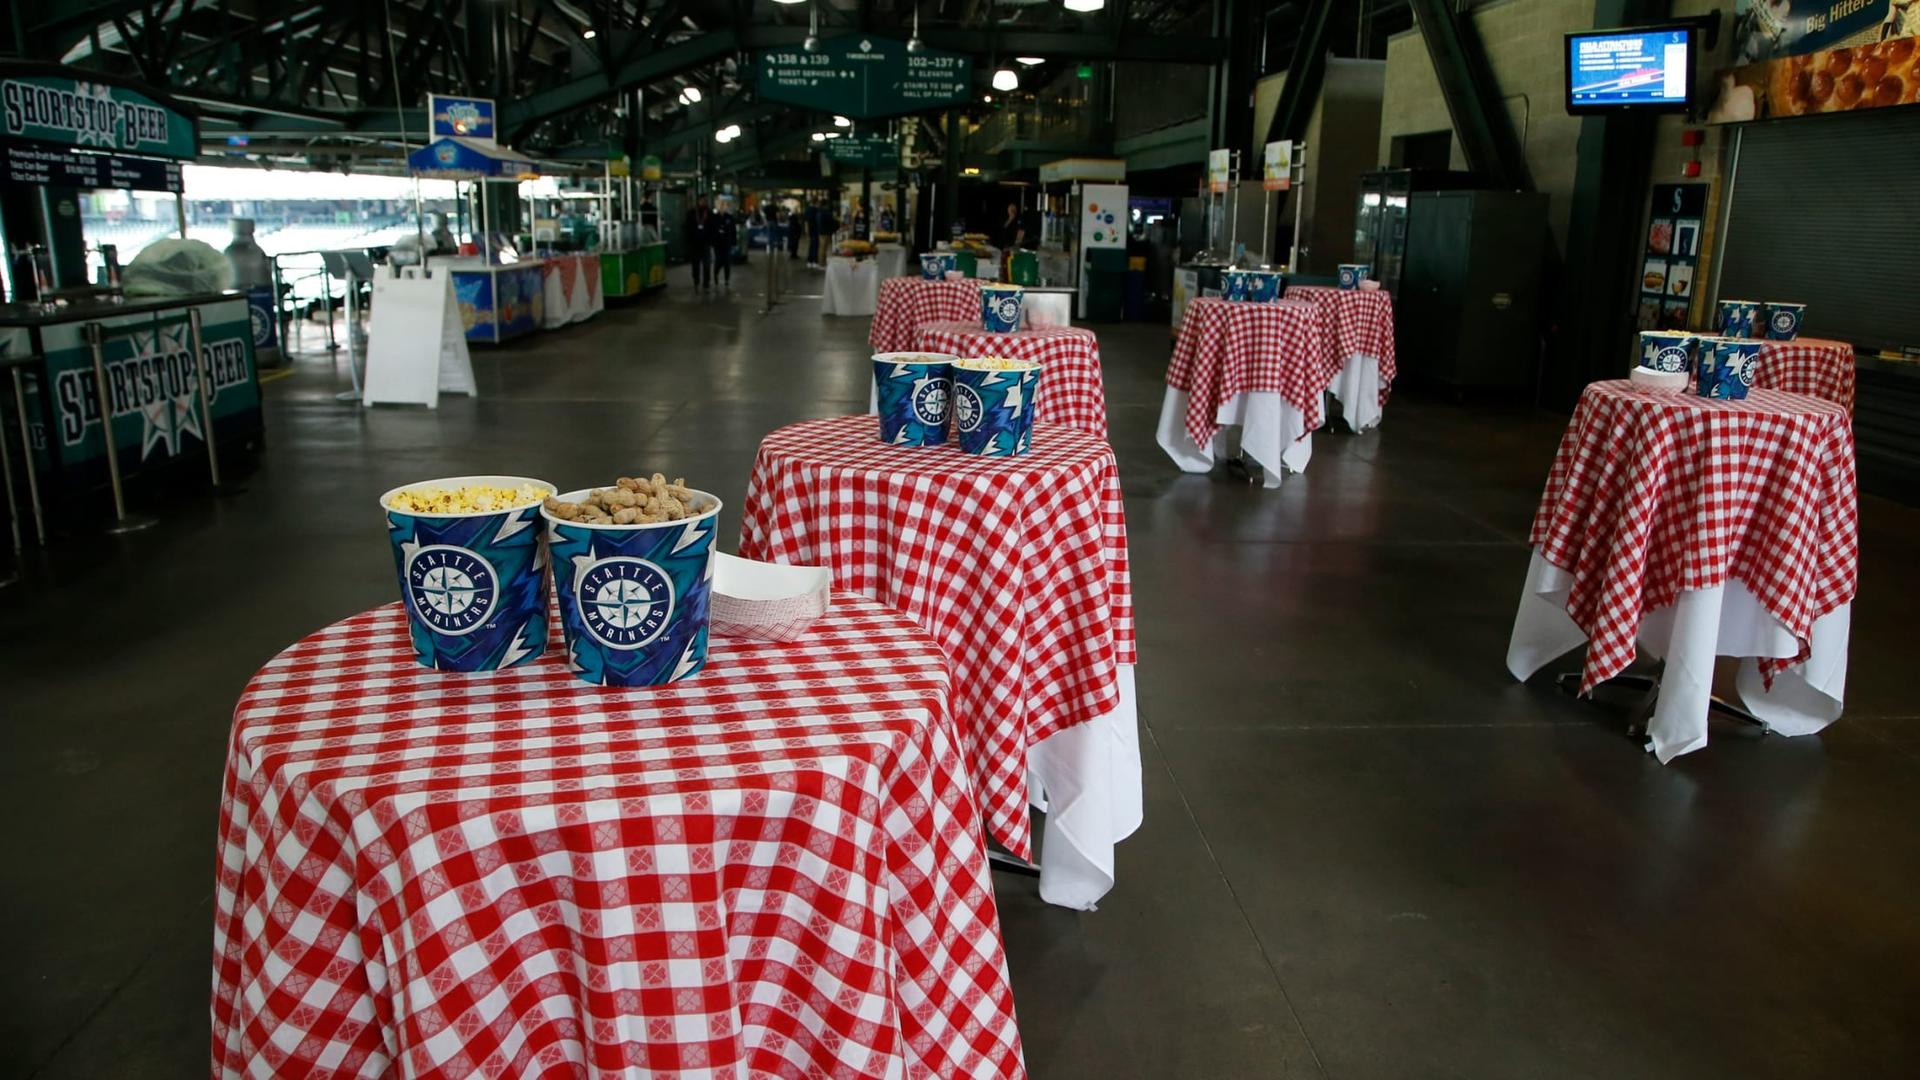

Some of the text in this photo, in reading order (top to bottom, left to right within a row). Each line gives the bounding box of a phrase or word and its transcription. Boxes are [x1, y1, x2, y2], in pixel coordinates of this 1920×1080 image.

[1806, 13, 1825, 34] Big
[777, 53, 798, 65] 138
[810, 54, 830, 65] 139
[777, 69, 836, 78] GUEST SERVICES
[918, 70, 954, 78] ELEVATOR
[929, 82, 939, 90] TO
[3, 80, 168, 148] SHORTSTOP BEER
[1672, 187, 1683, 213] S
[57, 353, 193, 445] SHRTSTOP
[413, 553, 485, 581] SEATTLE
[585, 565, 663, 593] SEATTLE
[417, 597, 488, 627] MARINERS
[587, 609, 664, 641] MARINERS
